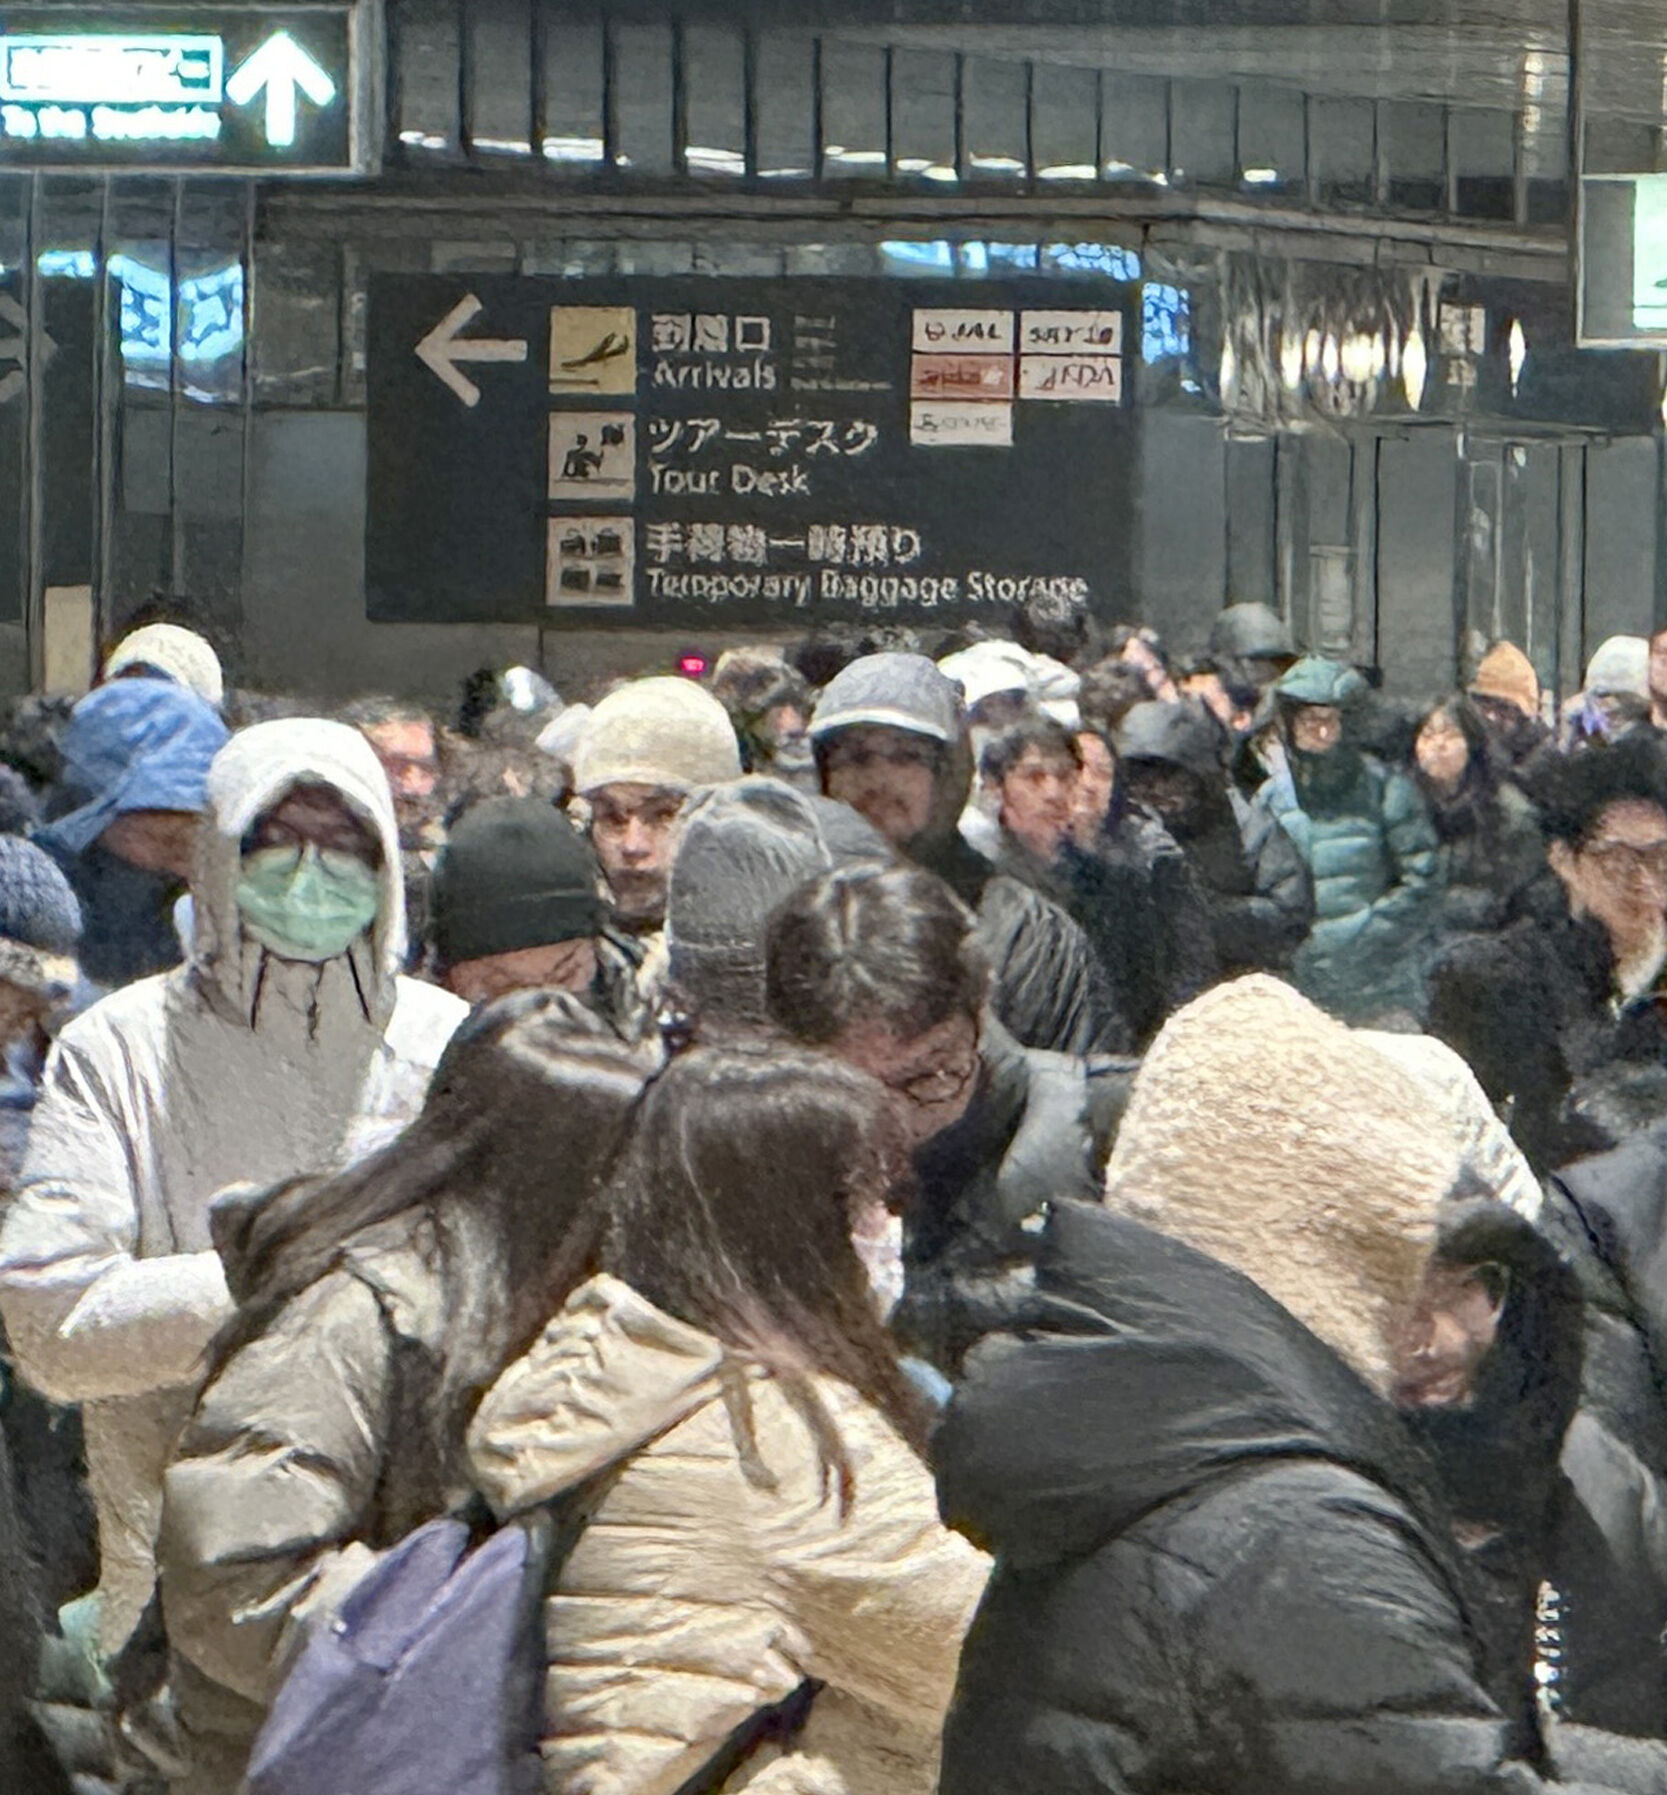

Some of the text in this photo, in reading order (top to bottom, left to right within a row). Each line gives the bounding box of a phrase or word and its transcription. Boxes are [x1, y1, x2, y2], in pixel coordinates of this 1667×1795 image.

[650, 359, 777, 391] Arrivals
[648, 417, 880, 456] ツアーデスク
[650, 462, 812, 497] Tour Desk
[646, 567, 811, 606] Temporary
[820, 568, 959, 606] Baggage
